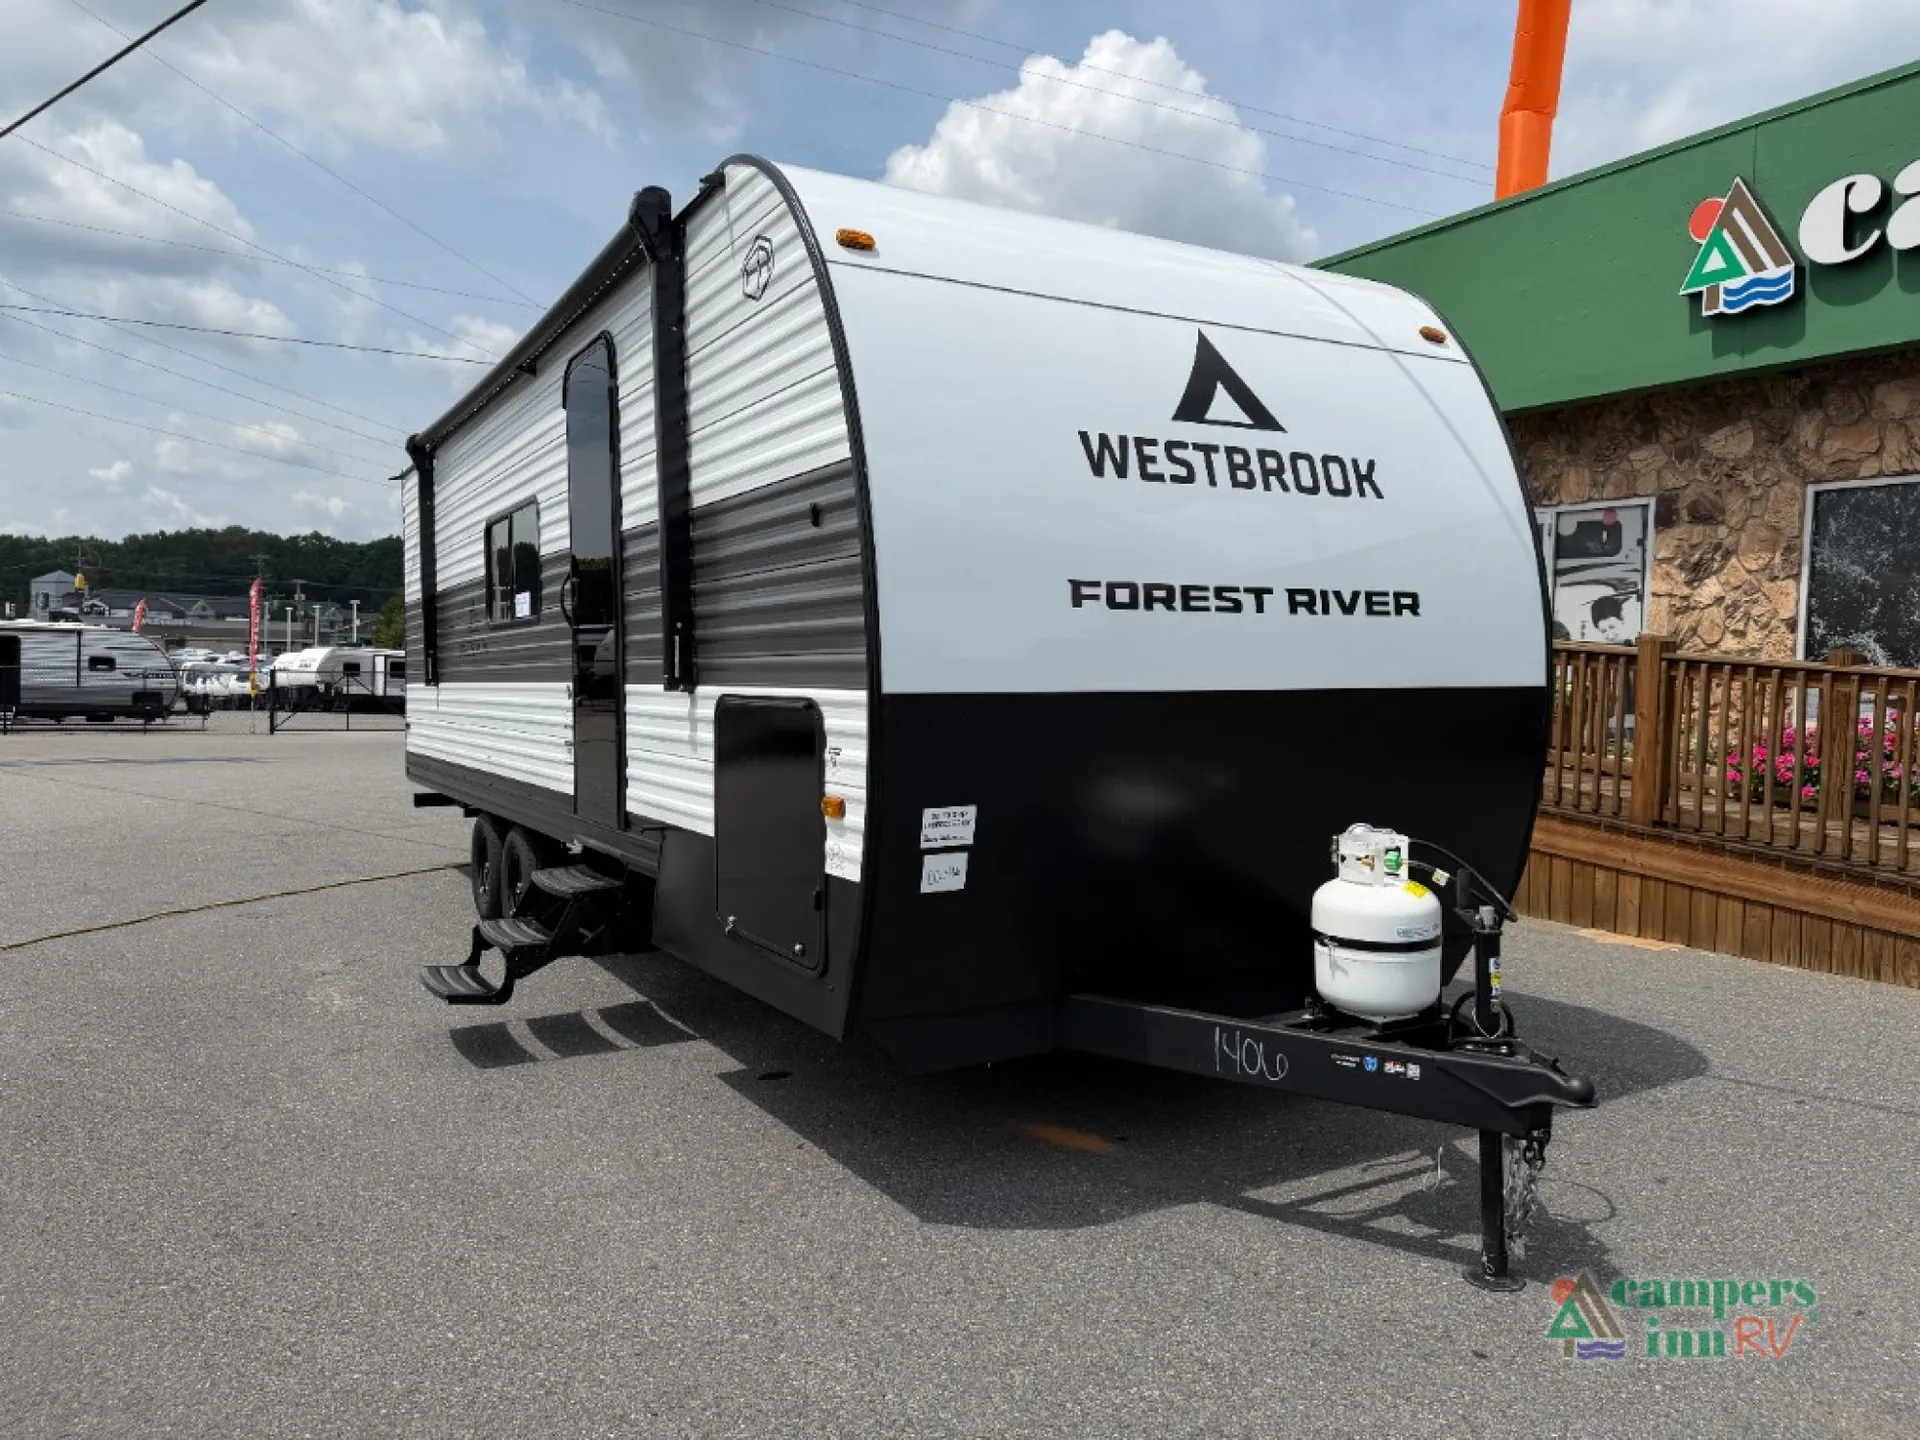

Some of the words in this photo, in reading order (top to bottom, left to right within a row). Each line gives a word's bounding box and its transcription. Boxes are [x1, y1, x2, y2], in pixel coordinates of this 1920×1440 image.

[1077, 430, 1385, 499] WESTBROOK
[1067, 579, 1274, 614] FOREST
[1285, 588, 1421, 617] RIVER
[1213, 1026, 1289, 1081] 1406
